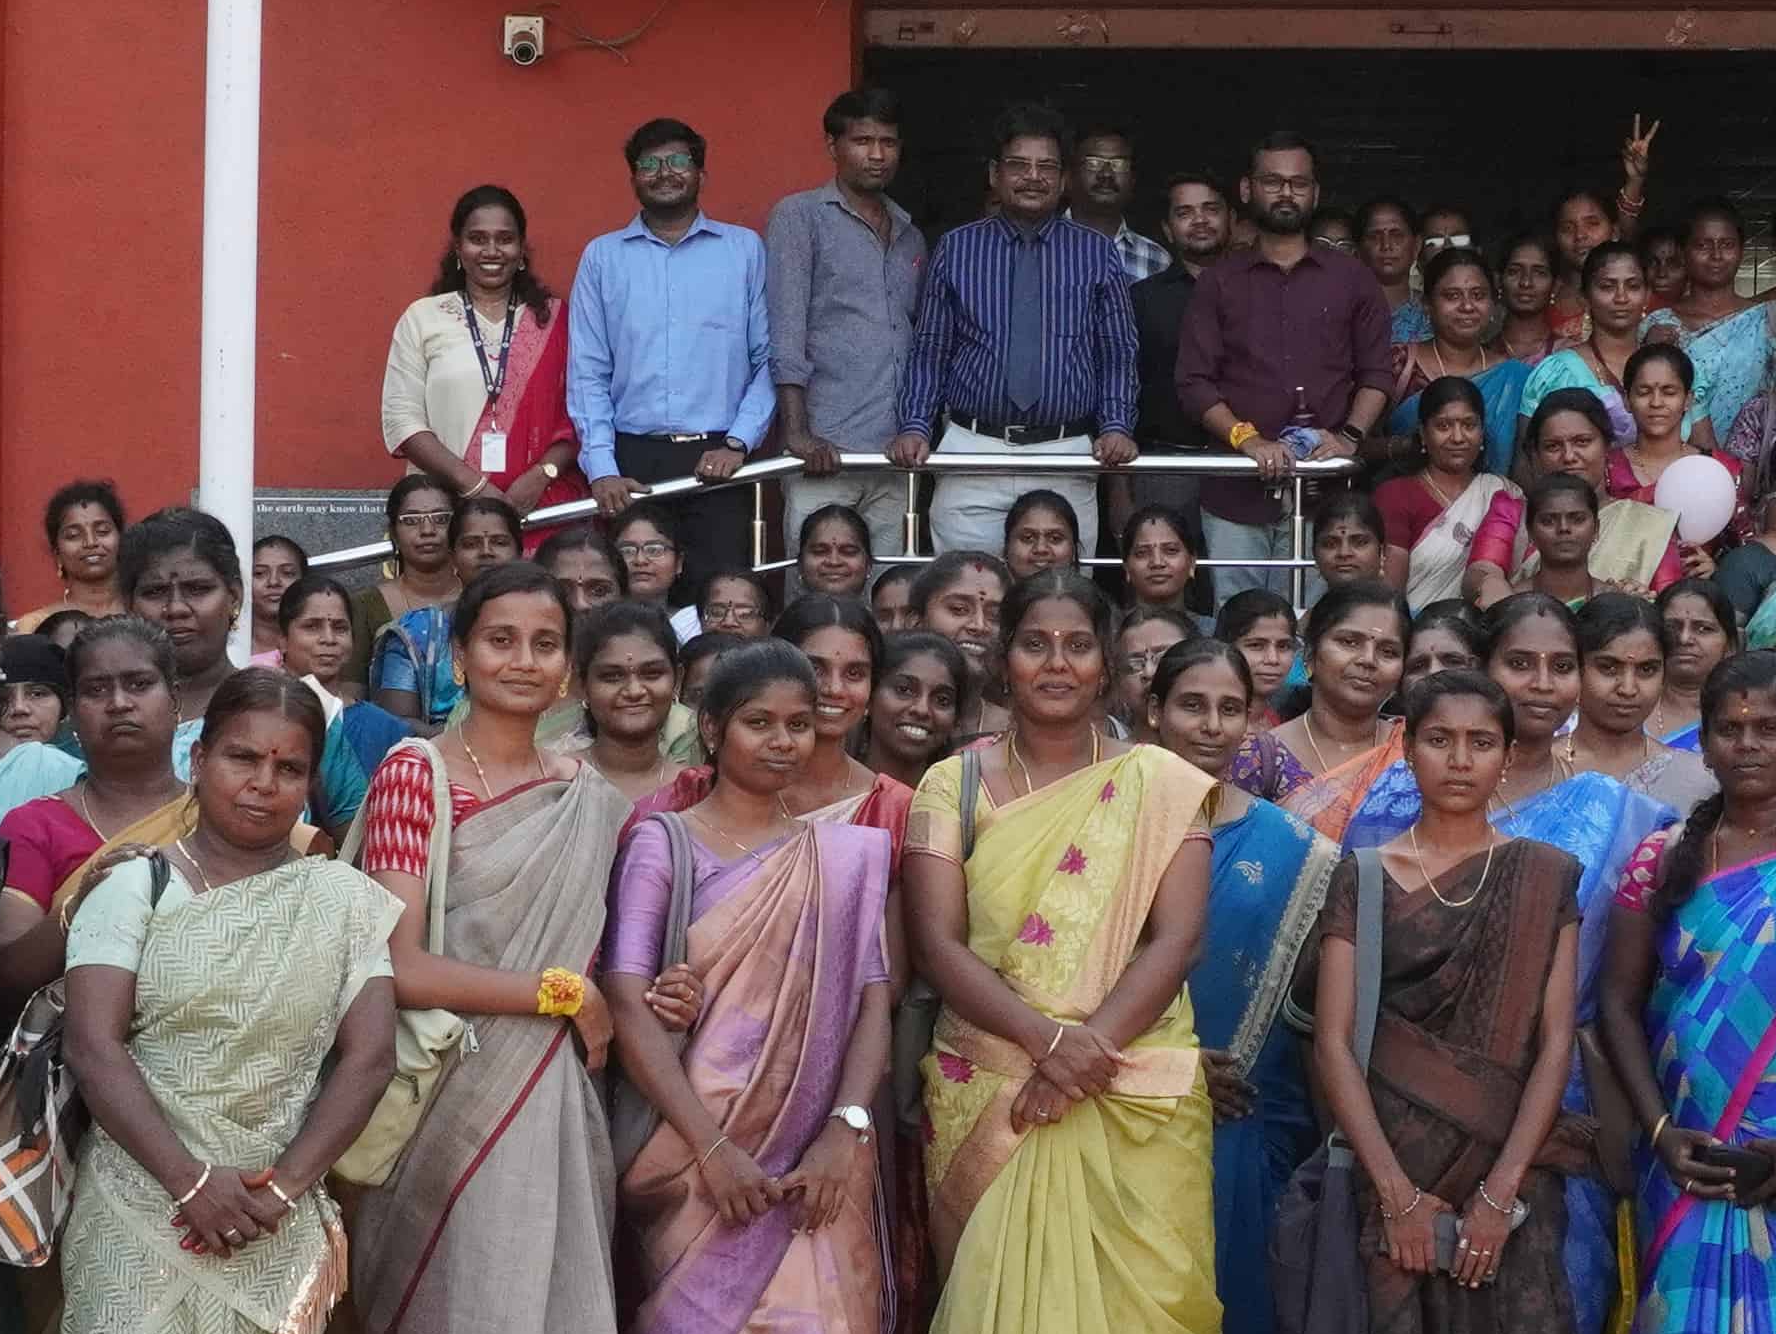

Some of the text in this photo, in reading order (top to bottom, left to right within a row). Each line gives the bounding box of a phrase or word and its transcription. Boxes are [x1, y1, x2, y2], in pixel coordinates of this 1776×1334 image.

[256, 504, 273, 513] the
[275, 504, 304, 513] earth
[306, 505, 328, 515] may
[329, 503, 357, 513] know
[359, 504, 381, 514] that
